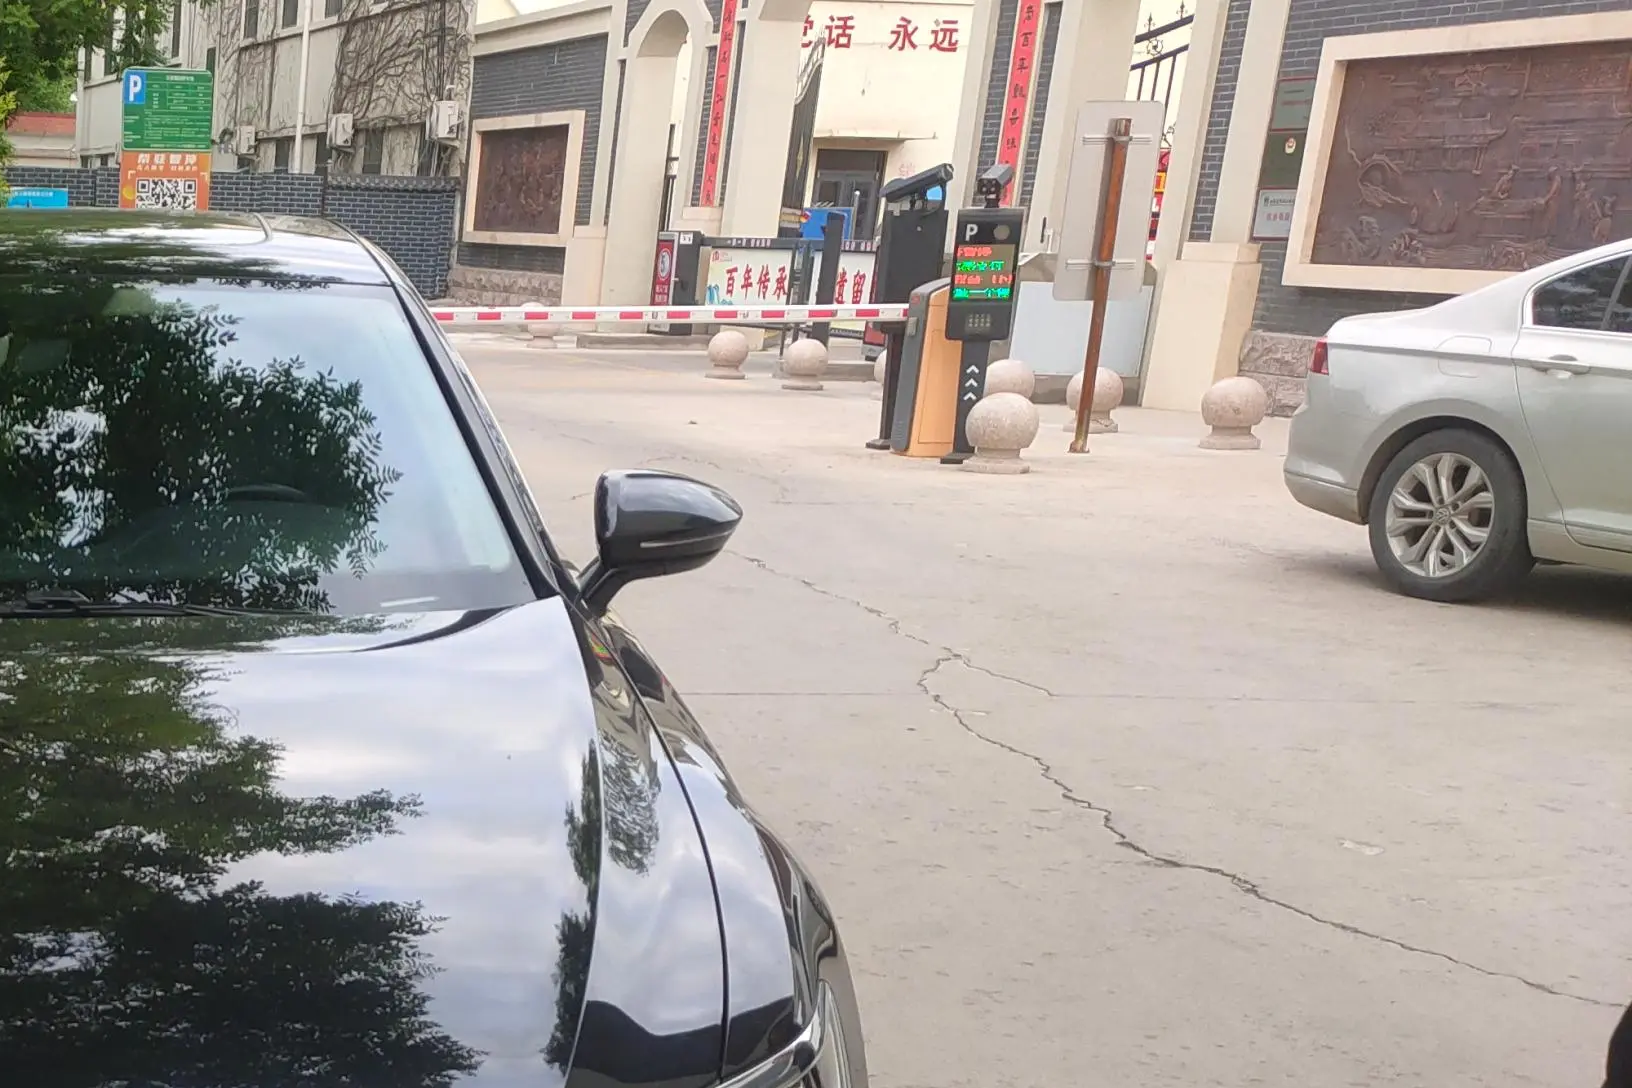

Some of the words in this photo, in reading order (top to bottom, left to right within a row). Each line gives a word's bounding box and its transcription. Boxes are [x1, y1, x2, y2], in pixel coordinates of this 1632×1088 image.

[888, 16, 959, 52] 永远
[128, 74, 142, 102] P
[965, 223, 978, 241] P
[725, 264, 788, 300] 百年传承
